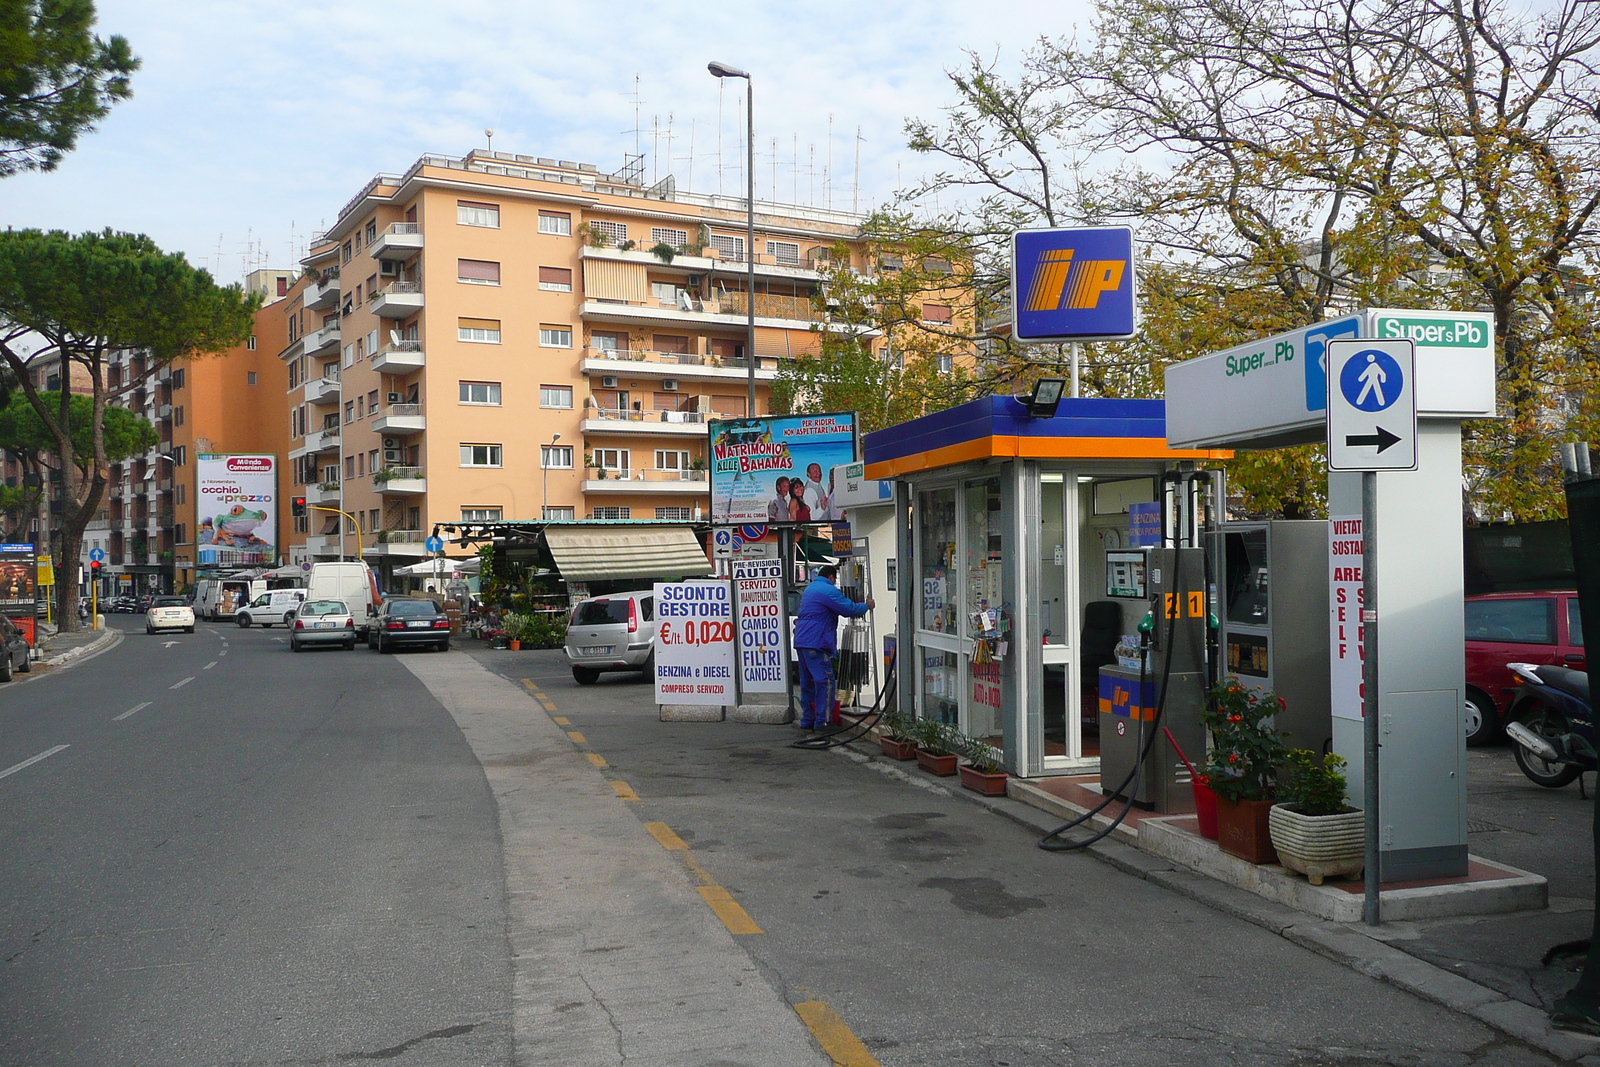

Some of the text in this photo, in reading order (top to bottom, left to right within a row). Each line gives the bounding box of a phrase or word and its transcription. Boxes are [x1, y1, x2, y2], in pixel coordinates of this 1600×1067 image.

[1226, 352, 1265, 377] Super
[1275, 341, 1294, 364] Pb
[814, 418, 835, 426] RIDIRE
[796, 427, 828, 435] ASPETTARE
[714, 442, 782, 460] MATRIMONIO
[717, 456, 793, 473] ALLE BAHAMAS
[847, 480, 858, 492] Diesel
[225, 495, 272, 504] prezzo
[1144, 527, 1161, 536] PIOMB
[1333, 519, 1362, 535] VIETAT
[833, 540, 853, 551] BOSCH
[733, 559, 780, 568] PRE-REVISIONE
[735, 566, 781, 578] AUTO
[1333, 567, 1364, 582] ARE
[740, 579, 777, 590] SERVIZIO
[663, 586, 726, 600] SCONTO
[741, 590, 778, 603] MANUTENZIONE
[659, 602, 729, 617] GESTORE
[1190, 595, 1198, 613] 1
[742, 605, 778, 617] AUTO
[741, 618, 778, 630] CAMBIO
[1336, 587, 1347, 659] SELF
[685, 621, 734, 647] 0,020
[742, 631, 779, 647] OLIO
[743, 650, 781, 667] FILTRI
[658, 665, 731, 678] BENZINA e DIESEL
[744, 667, 782, 681] CANDELE
[661, 684, 724, 694] COMPRESO SERVIZIO
